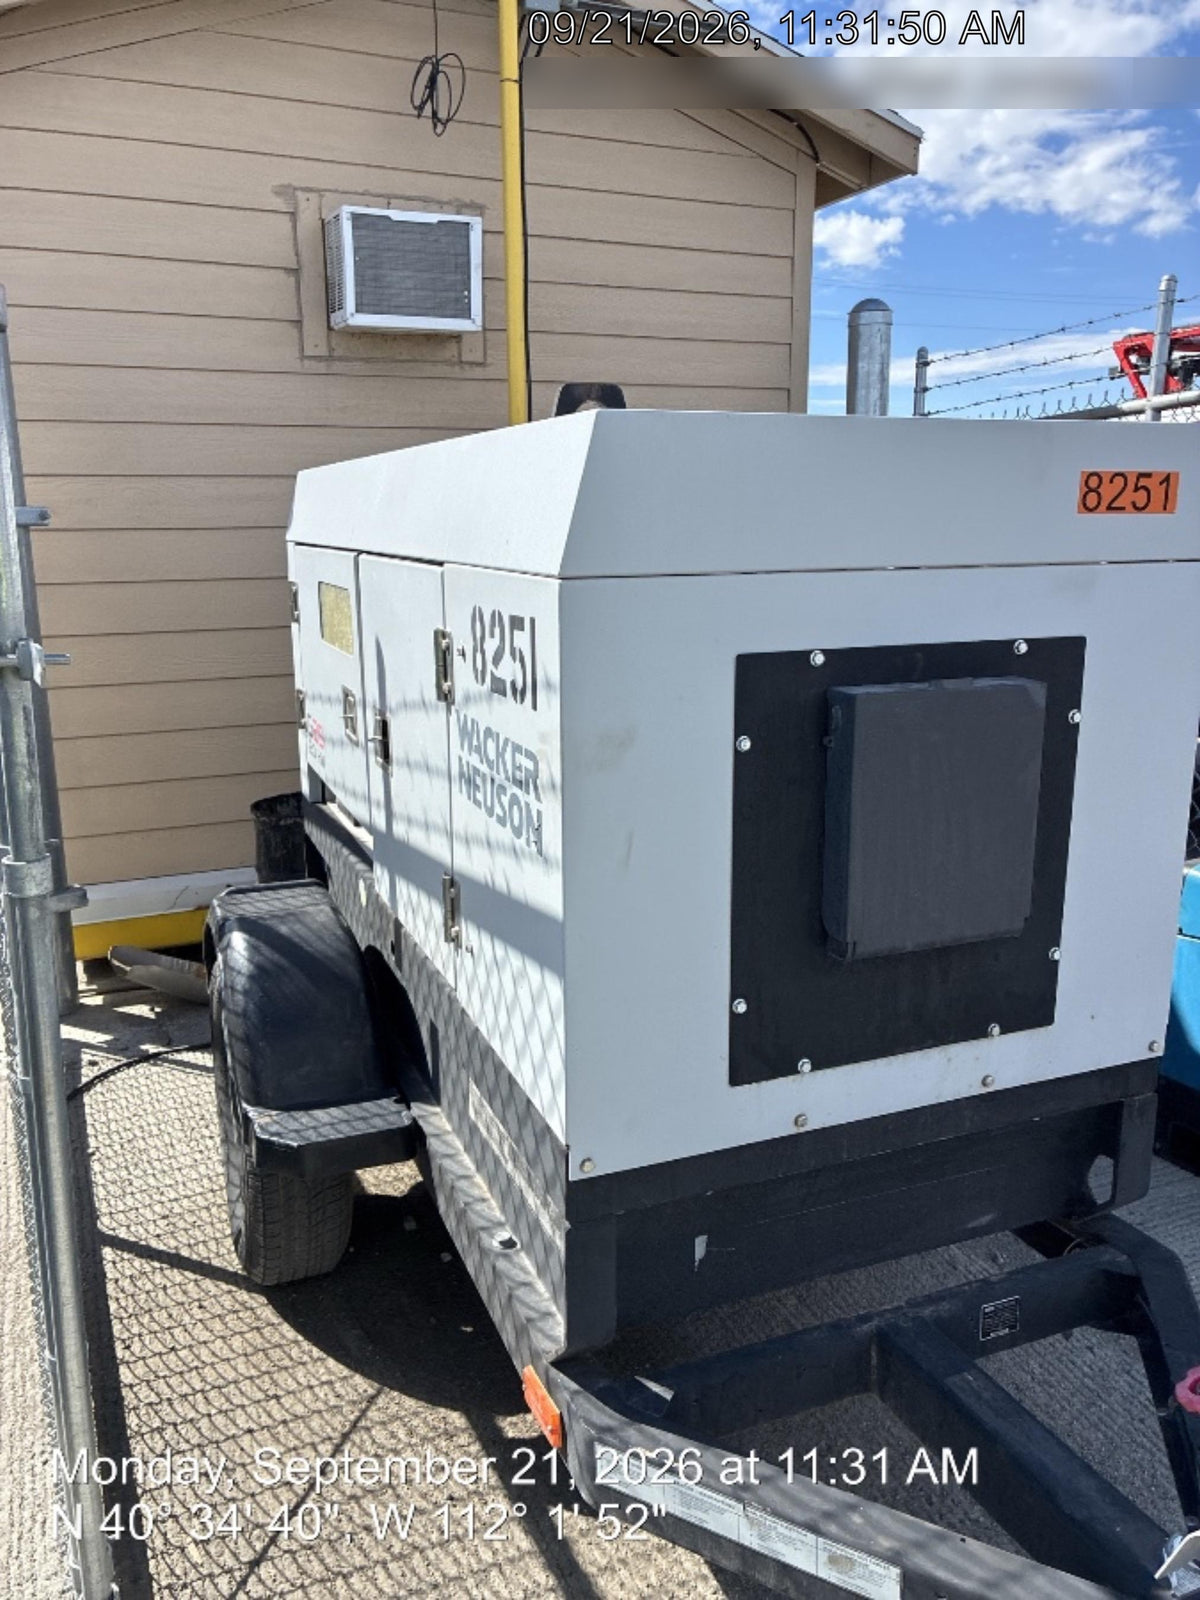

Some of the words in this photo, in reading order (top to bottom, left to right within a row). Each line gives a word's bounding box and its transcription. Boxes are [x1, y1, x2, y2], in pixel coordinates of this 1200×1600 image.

[1081, 471, 1172, 512] 8251
[471, 604, 538, 712] 8251
[455, 708, 543, 804] WACKER
[458, 755, 544, 857] NEUSON
